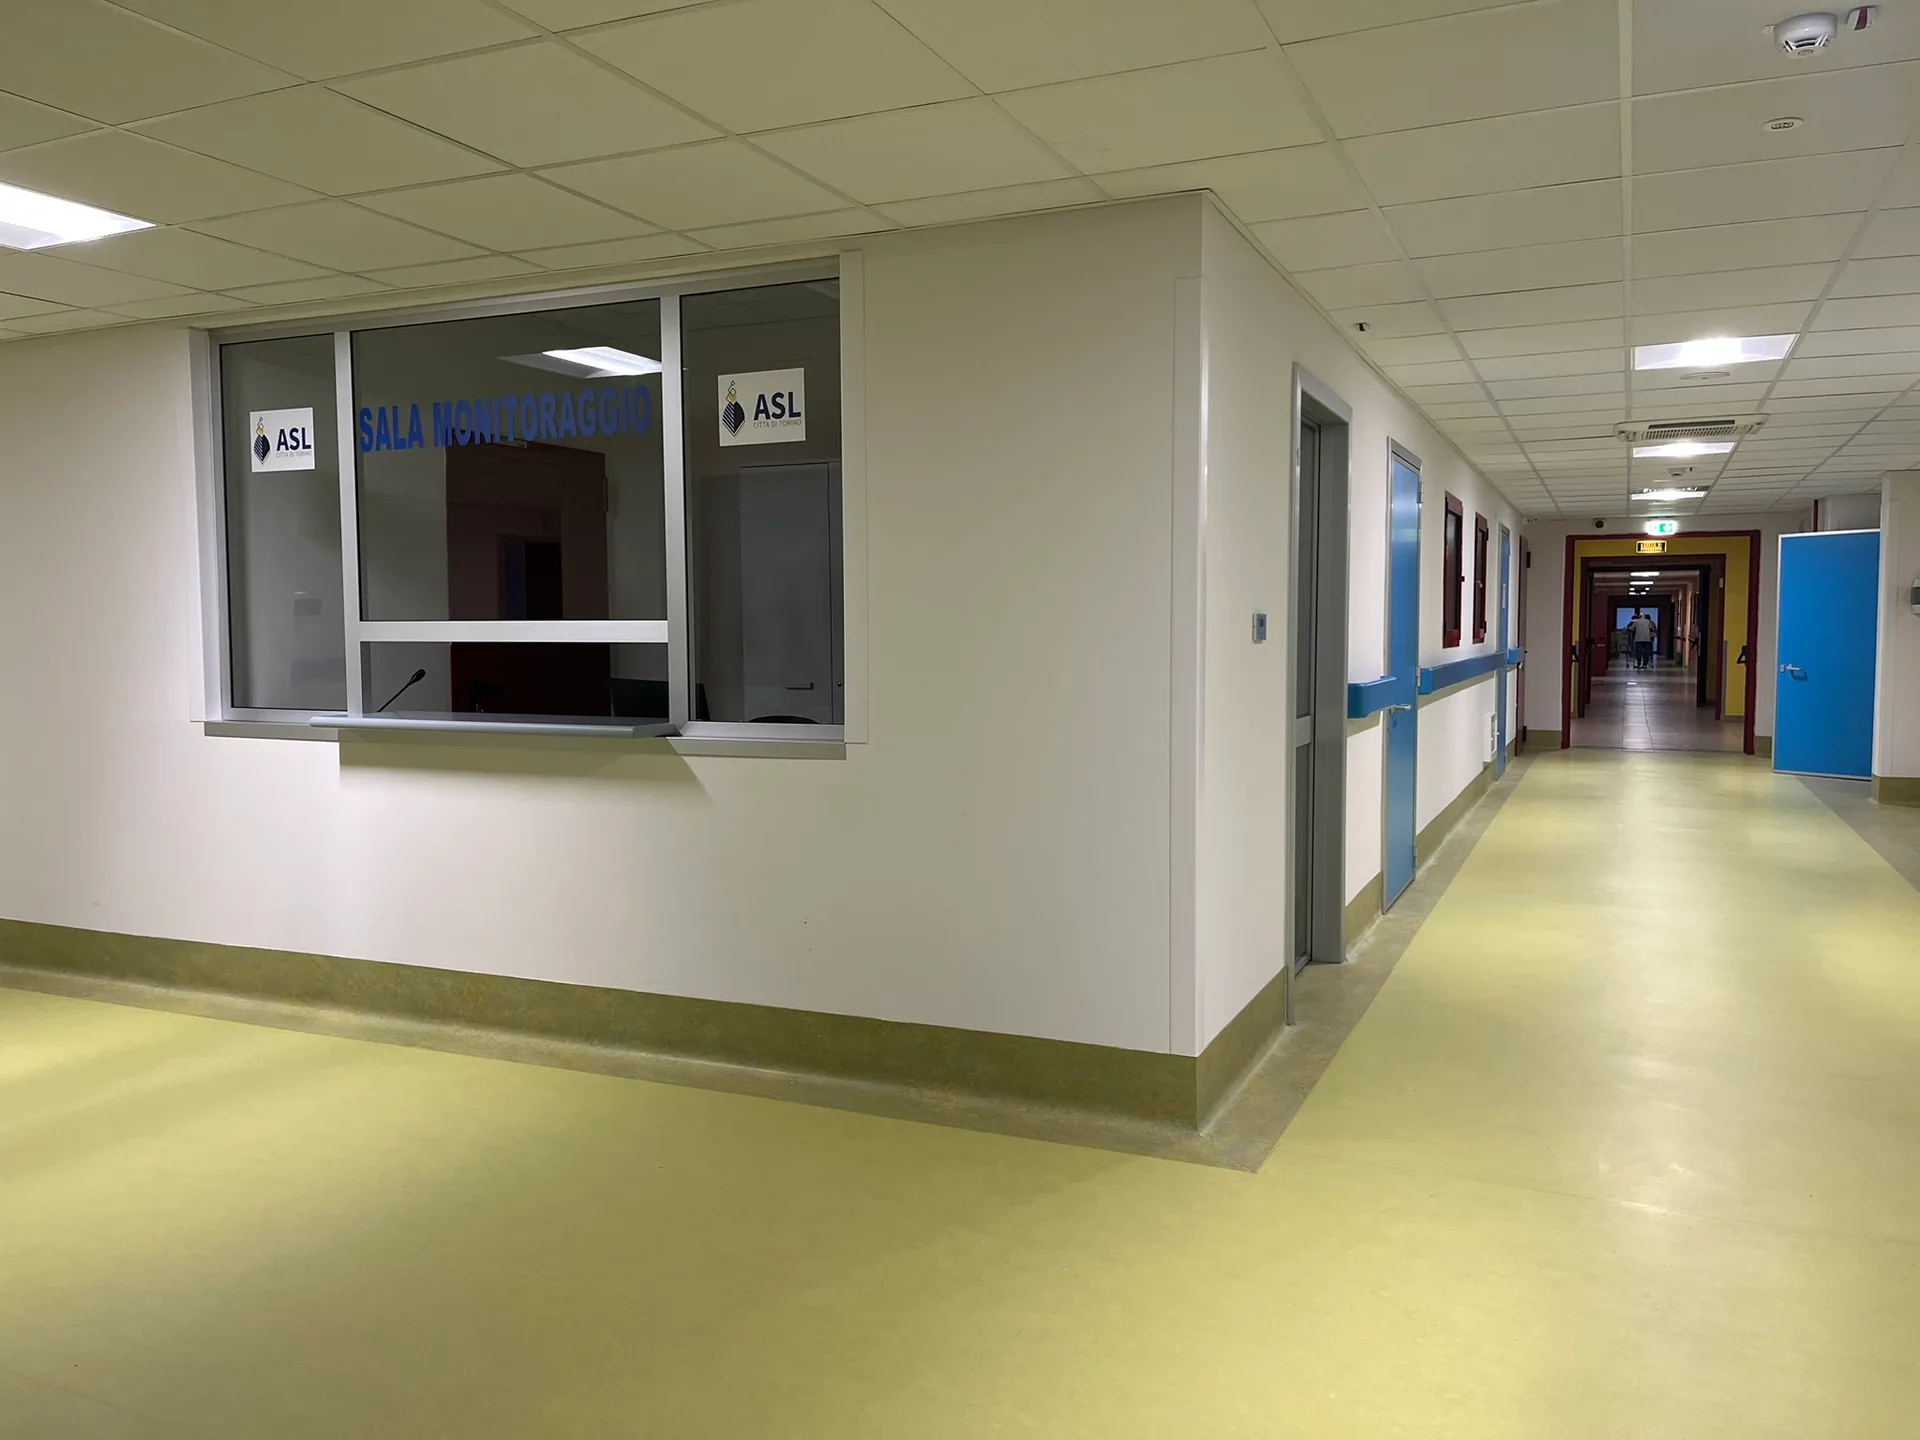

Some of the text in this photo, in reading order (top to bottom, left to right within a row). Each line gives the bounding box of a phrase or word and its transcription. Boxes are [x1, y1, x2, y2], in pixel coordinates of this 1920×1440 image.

[360, 384, 650, 452] SALA MONITORAGGIO
[753, 391, 801, 420] ASL
[276, 427, 312, 451] ASL
